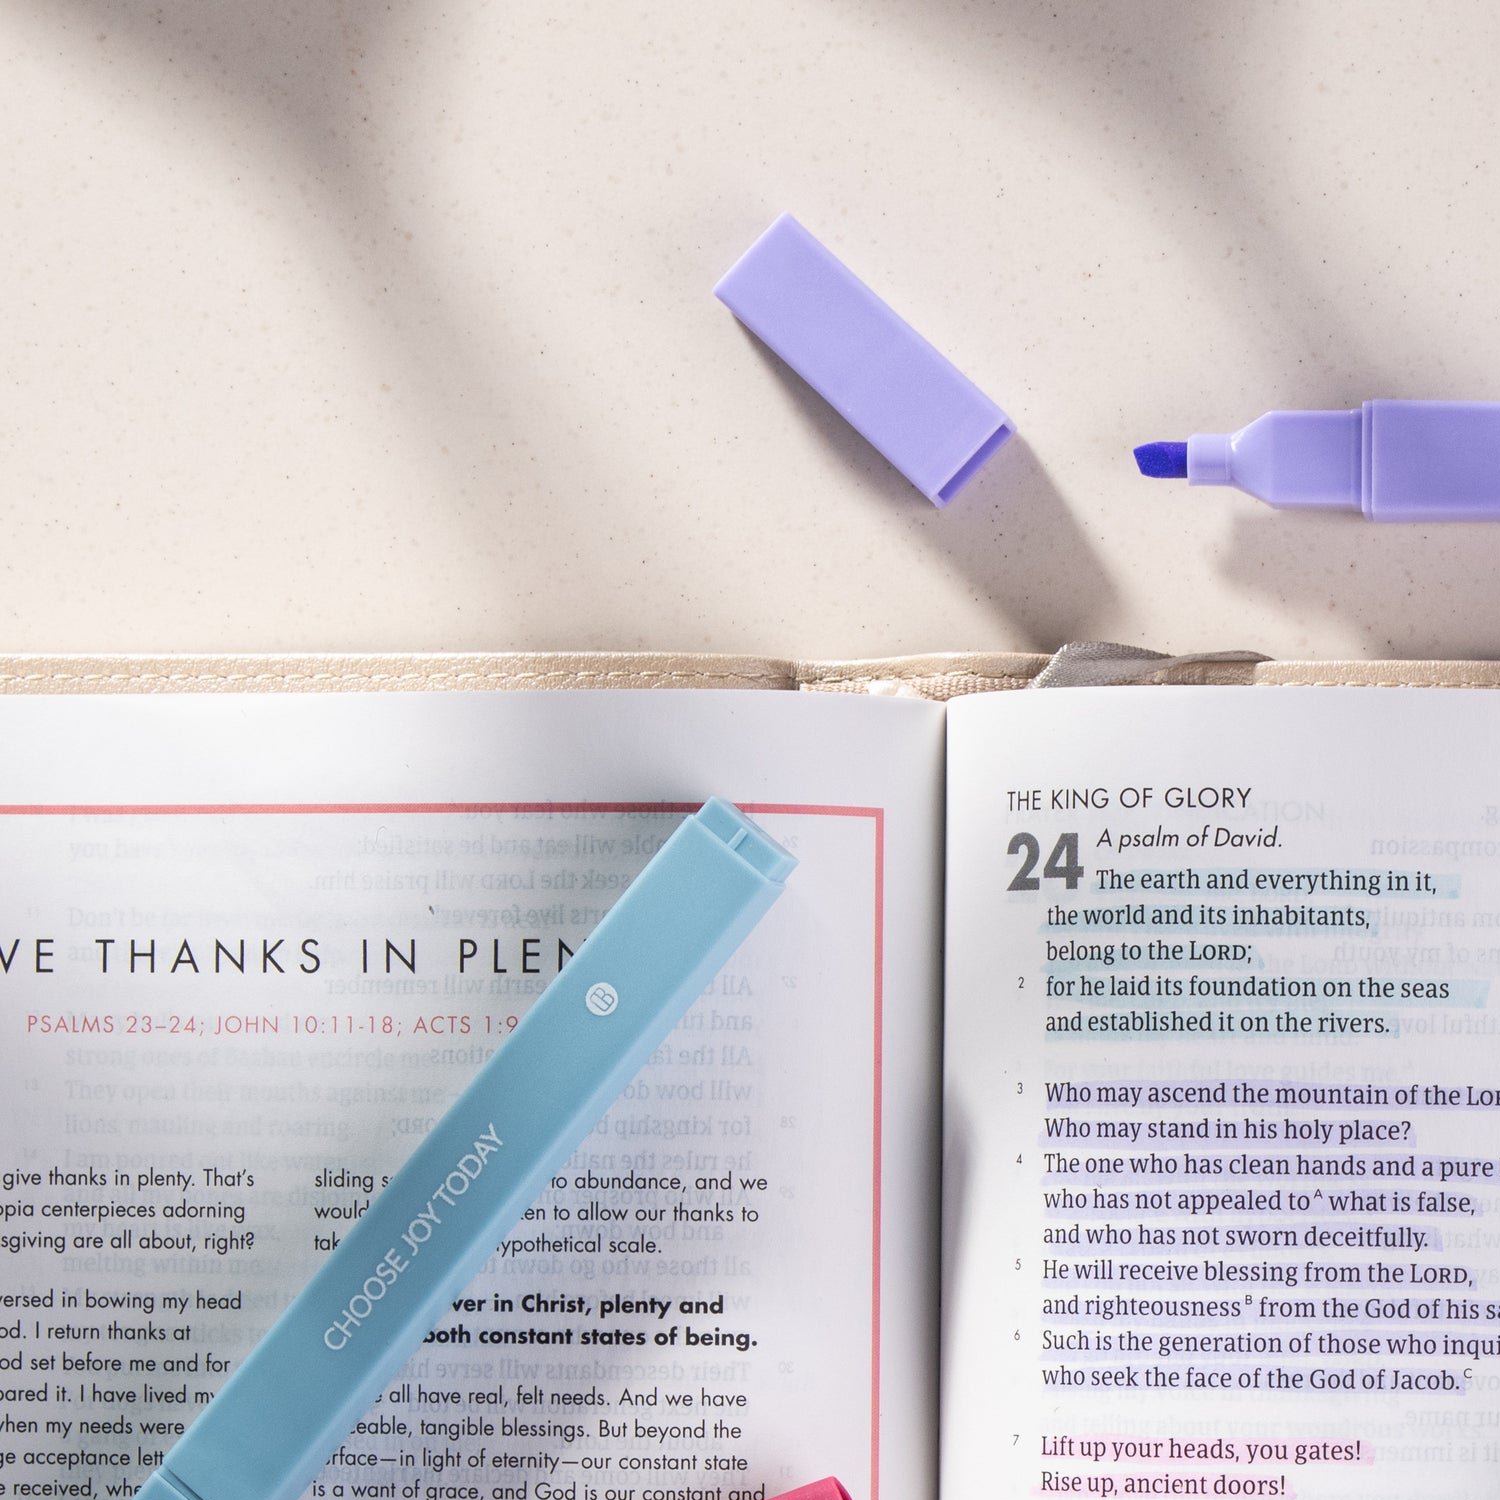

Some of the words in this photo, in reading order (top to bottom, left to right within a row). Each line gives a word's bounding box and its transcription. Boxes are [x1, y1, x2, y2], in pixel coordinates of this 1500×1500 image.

[1007, 789, 1042, 812] THE
[1051, 787, 1110, 810] KING
[1119, 787, 1153, 809] OF
[1164, 787, 1252, 809] GLORY
[1096, 827, 1113, 848] A
[1118, 824, 1180, 854] psalm
[1186, 824, 1211, 848] of
[1214, 824, 1282, 848] David.
[1006, 831, 1085, 892] 24
[1095, 868, 1135, 890] The
[1140, 868, 1201, 890] earth
[1206, 868, 1249, 890] and
[1255, 869, 1381, 896] everything
[1386, 870, 1410, 892] in
[1415, 870, 1437, 895] it,
[0, 938, 54, 974] VE
[95, 938, 321, 974] THANKS
[362, 938, 416, 974] IN
[459, 937, 588, 974] PLEN
[1046, 975, 1076, 997] for
[1079, 975, 1105, 997] he
[1109, 975, 1151, 996] laid
[1156, 975, 1183, 996] its
[1189, 974, 1317, 997] foundation
[1322, 981, 1352, 998] on
[1358, 976, 1395, 998] the
[1400, 982, 1450, 999] seas
[27, 1014, 114, 1034] PSALMS
[214, 1015, 281, 1035] JOHN
[412, 1015, 471, 1034] ACTS
[324, 1247, 410, 1351] CHOOSE
[401, 1200, 442, 1257] JOY
[432, 1122, 503, 1207] TODAY
[1041, 1435, 1075, 1457] Lift
[1079, 1441, 1107, 1462] up
[1111, 1441, 1164, 1462] your
[1168, 1437, 1240, 1463] heads,
[1245, 1444, 1289, 1465] you
[1294, 1440, 1361, 1466] gates!
